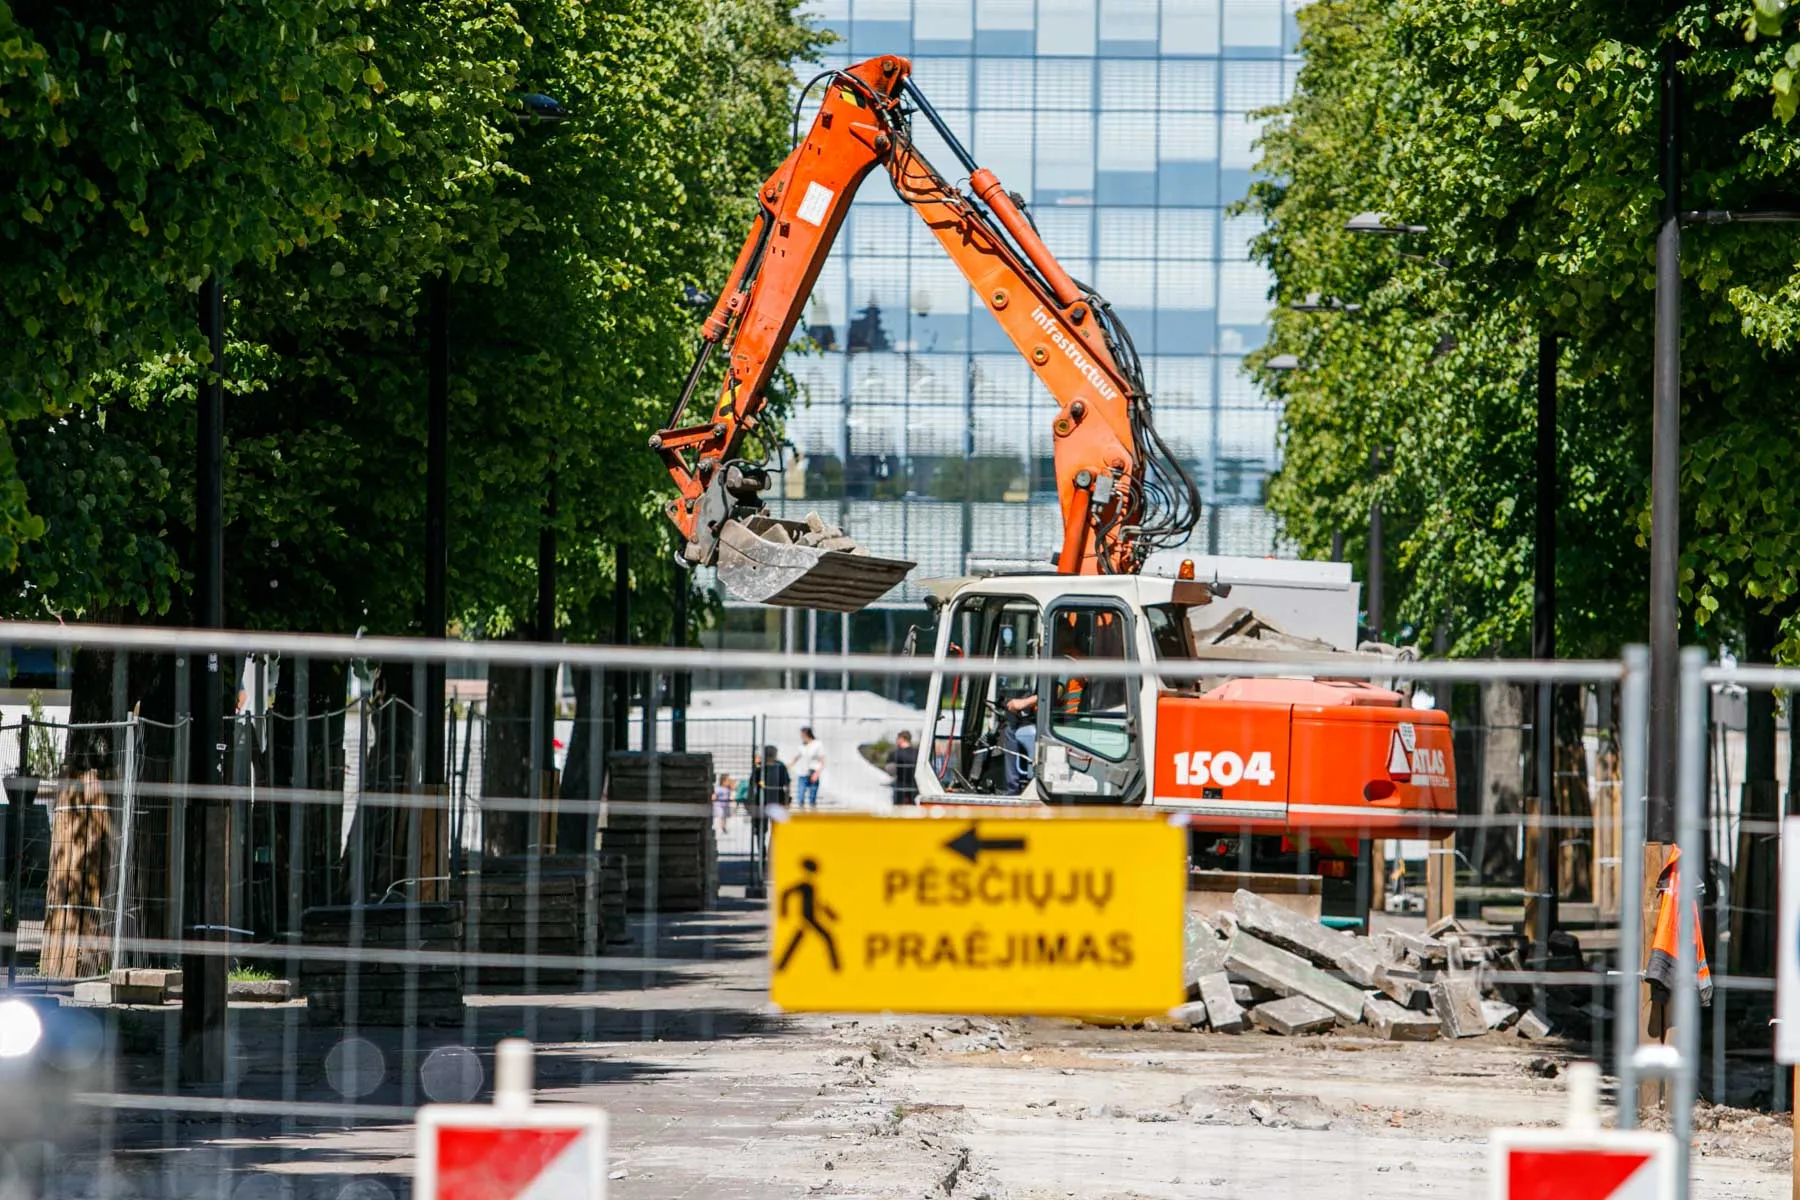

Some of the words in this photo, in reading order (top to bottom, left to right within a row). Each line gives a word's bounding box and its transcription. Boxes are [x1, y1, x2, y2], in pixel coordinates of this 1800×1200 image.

[1031, 304, 1118, 400] infrastructuur
[1173, 751, 1275, 786] 1504
[1412, 748, 1446, 775] ATLAS
[883, 861, 1114, 913] PĖSČIŲJŲ
[864, 924, 1135, 970] PRAĖJIMAS
